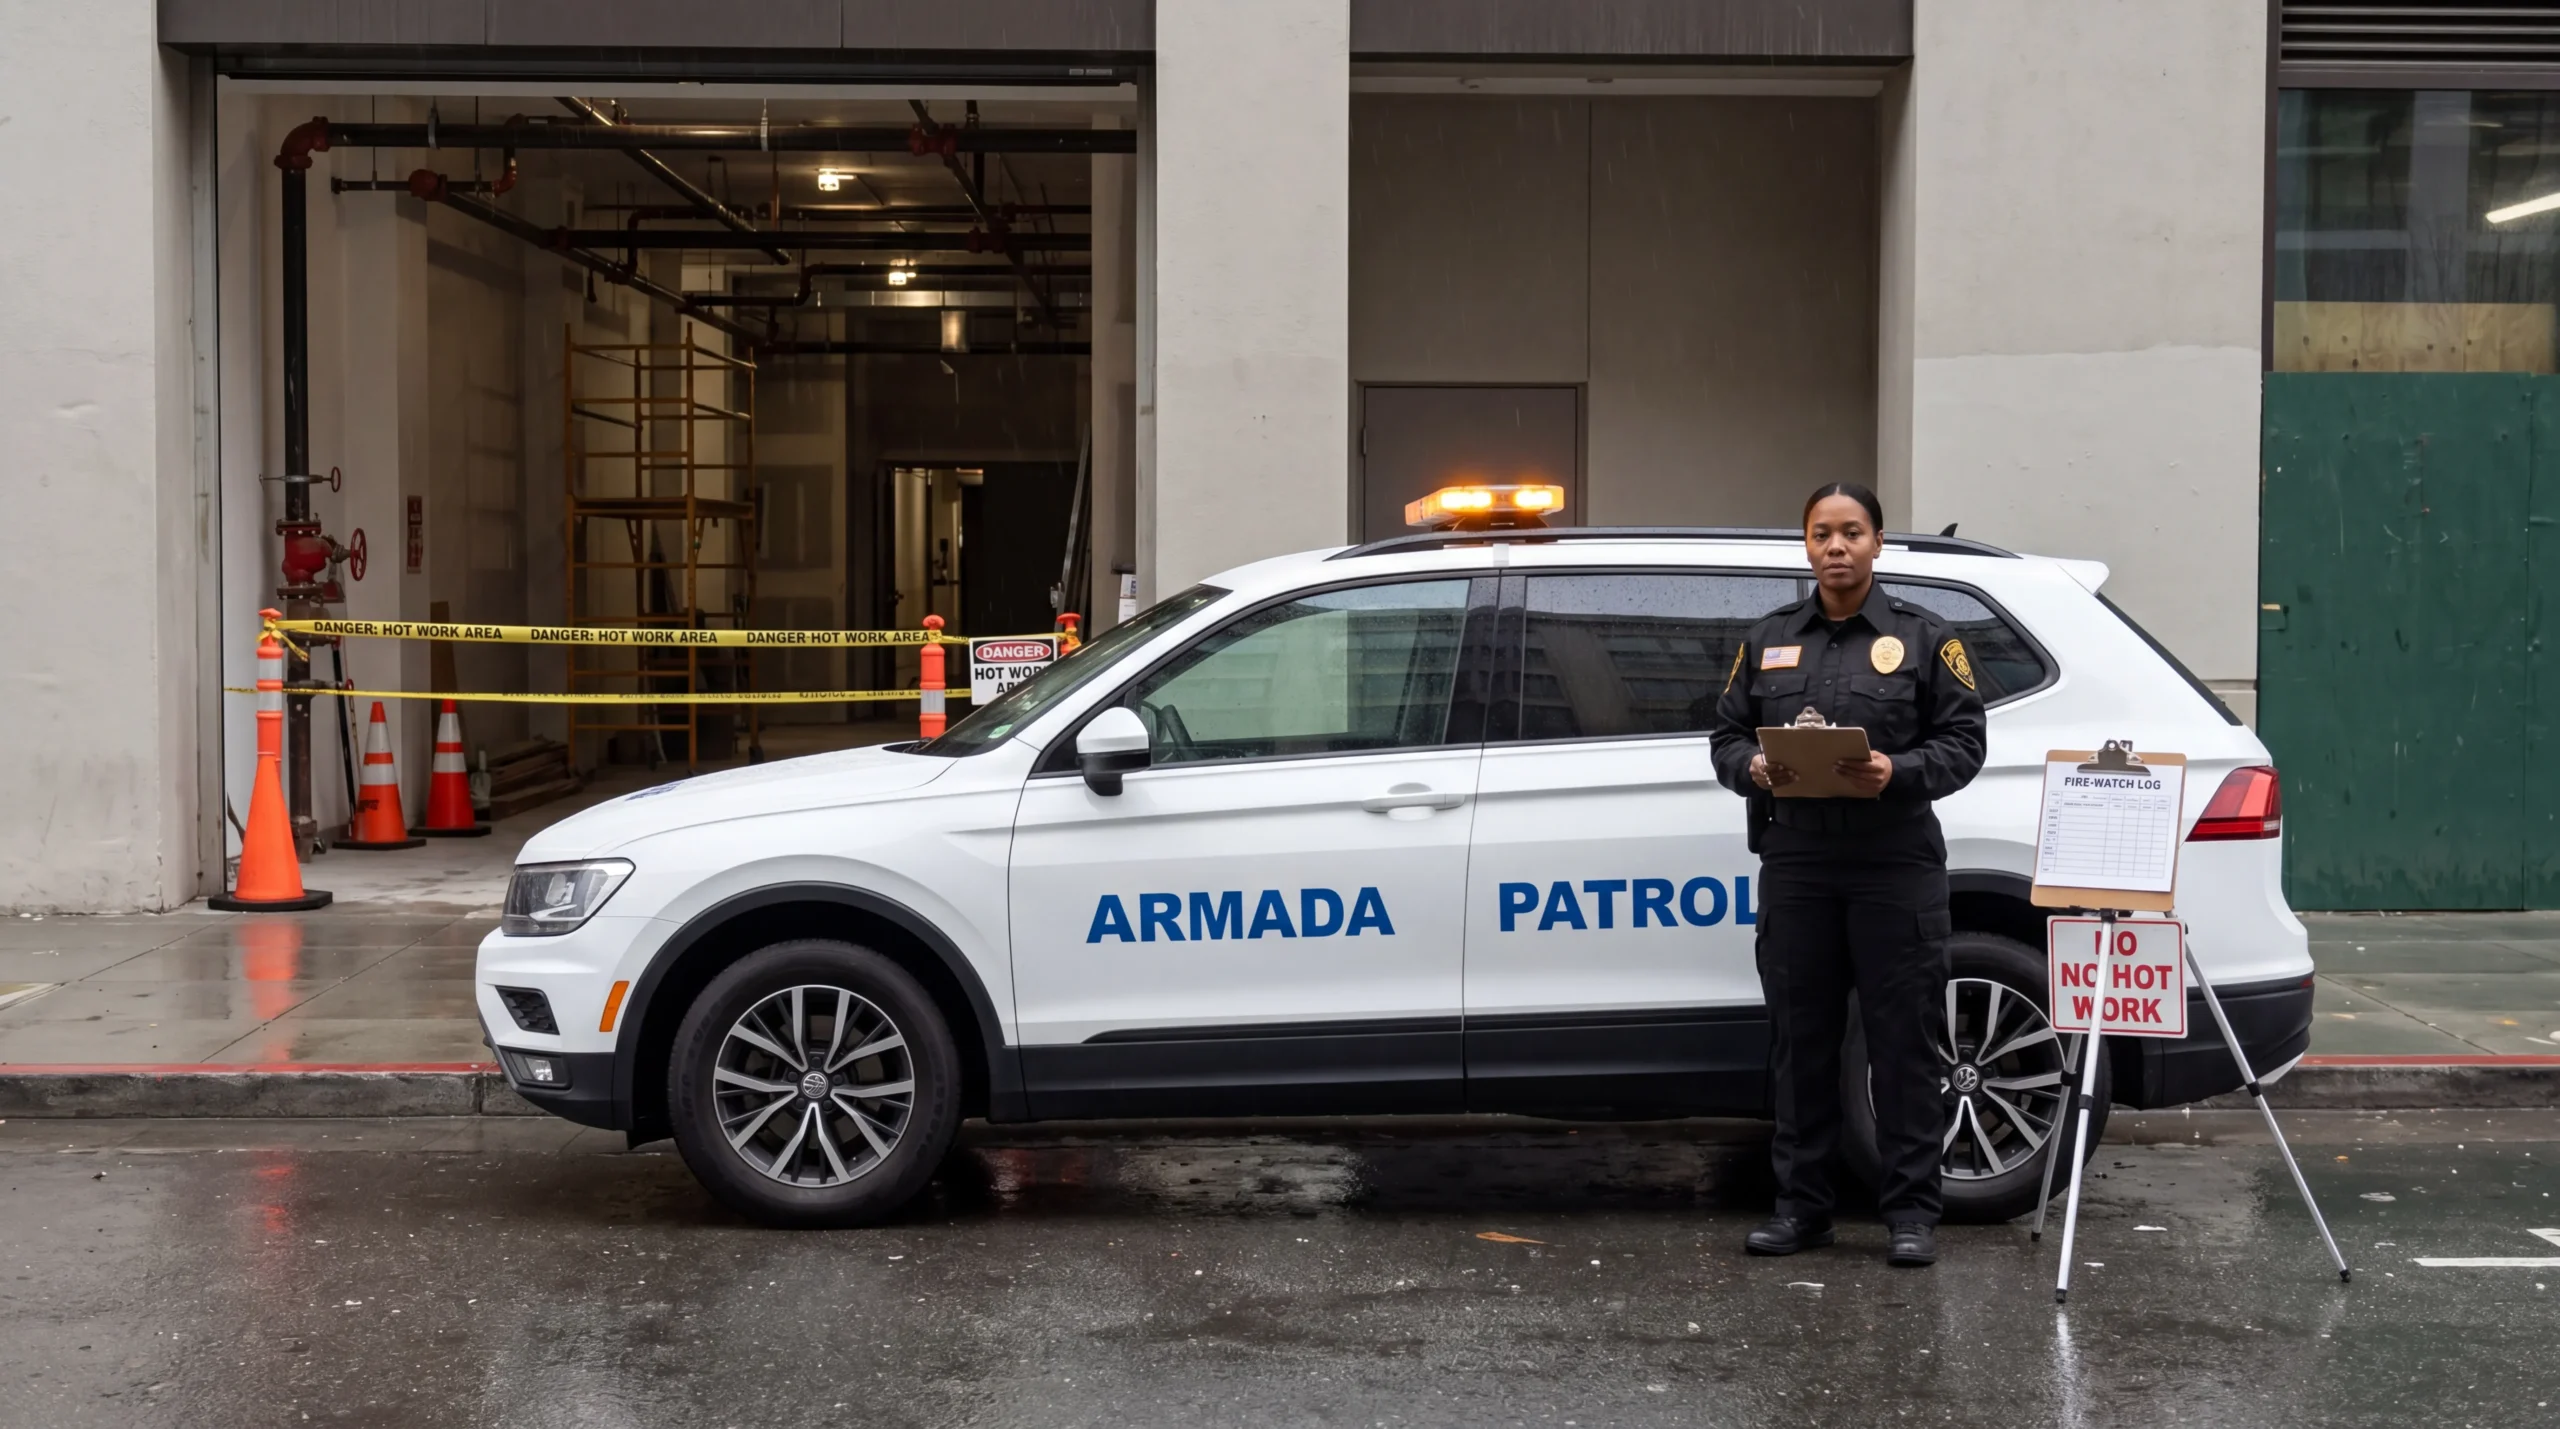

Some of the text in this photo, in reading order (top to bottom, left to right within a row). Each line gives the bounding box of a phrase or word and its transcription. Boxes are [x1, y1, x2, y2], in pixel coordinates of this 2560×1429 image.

[314, 622, 502, 639] DANGER: HOT WORK AREA
[531, 629, 717, 643] DANGER: HOT WORK AREA
[845, 632, 887, 643] WORK
[893, 632, 929, 642] AREA
[983, 646, 1044, 658] DANGER
[975, 666, 1047, 680] HOT WO
[2138, 780, 2161, 790] LOG
[1499, 876, 1757, 932] PATROL
[1087, 887, 1395, 944] ARMADA
[2113, 964, 2172, 990] HOT
[2072, 996, 2162, 1023] WORK
